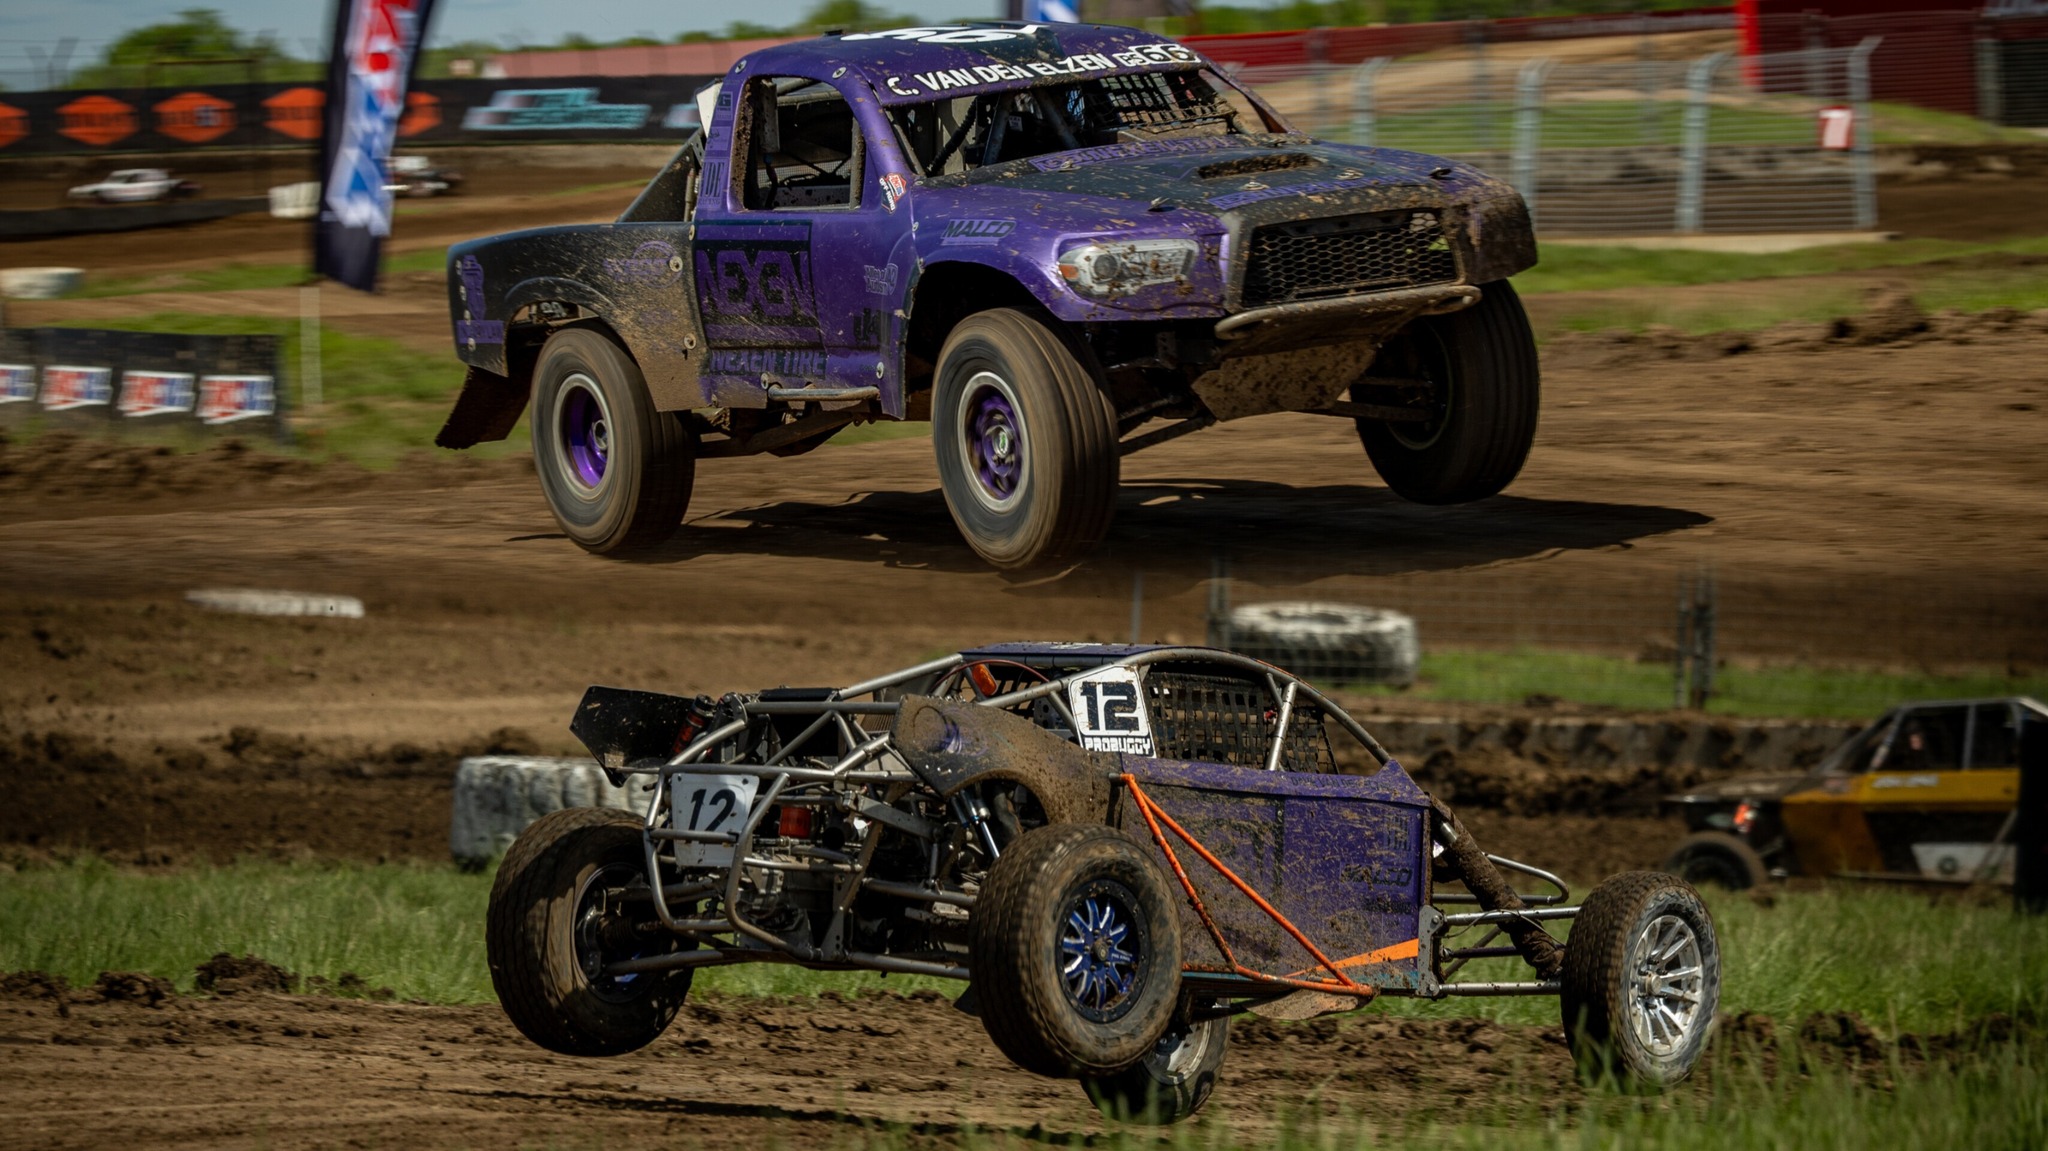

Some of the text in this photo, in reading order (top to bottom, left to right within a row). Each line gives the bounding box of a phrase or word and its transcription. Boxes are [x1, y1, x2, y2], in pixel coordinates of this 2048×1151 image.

[887, 76, 920, 96] C.
[914, 67, 979, 92] VAN
[975, 64, 1028, 85] DEN
[1026, 52, 1116, 77] ELZEN
[944, 220, 1014, 238] MALCO
[711, 352, 825, 376] NEXEN TIRE
[1081, 682, 1140, 731] 12
[1084, 737, 1151, 755] PROBUGGY
[689, 788, 736, 843] 12
